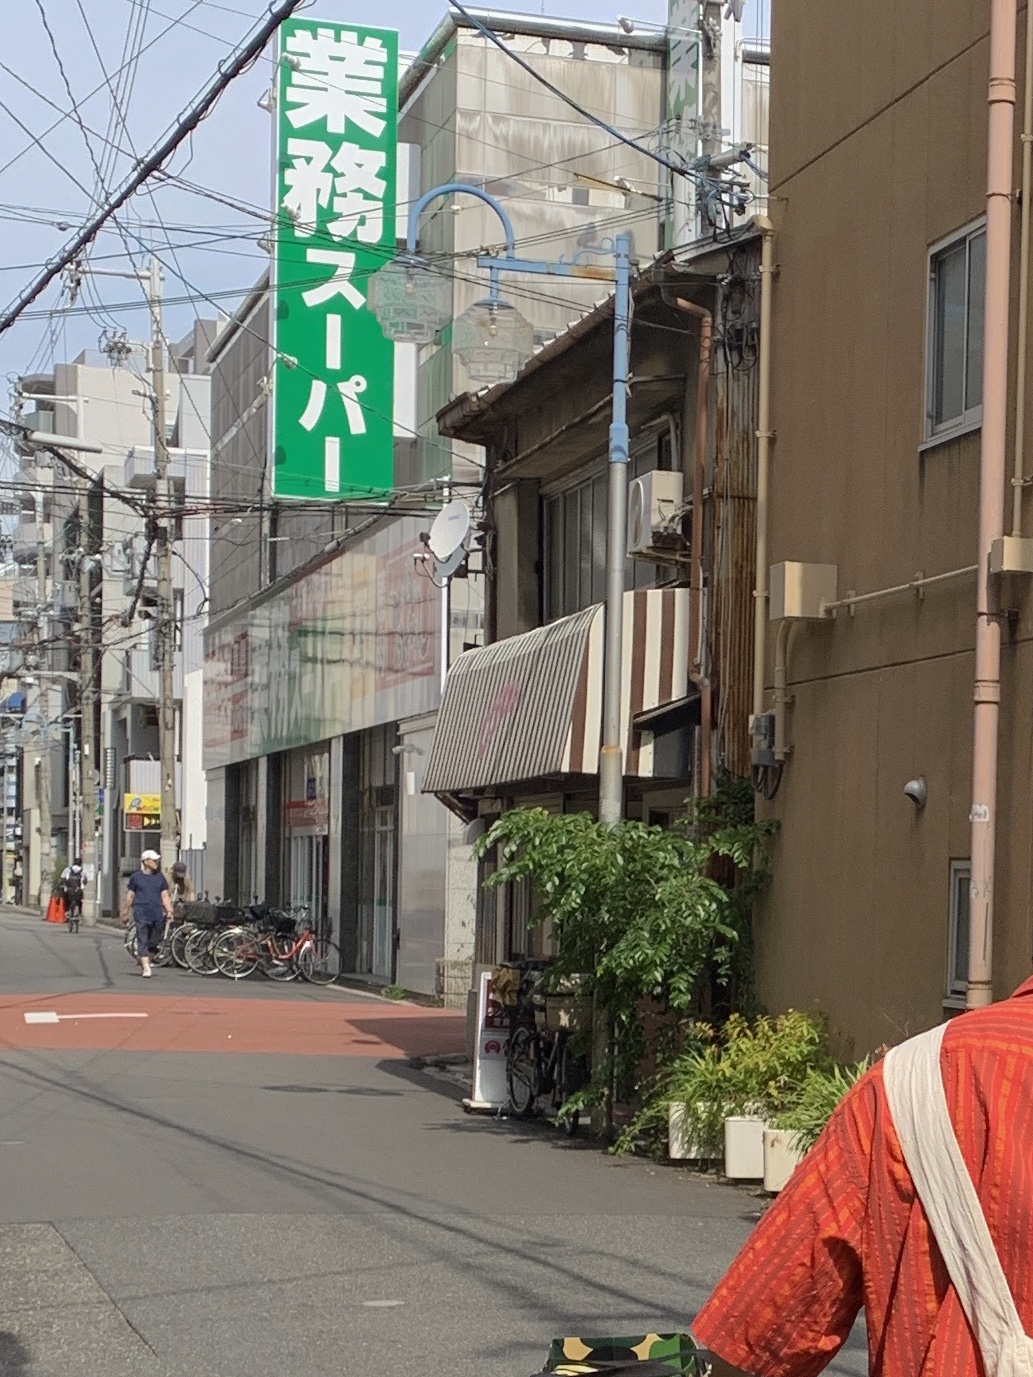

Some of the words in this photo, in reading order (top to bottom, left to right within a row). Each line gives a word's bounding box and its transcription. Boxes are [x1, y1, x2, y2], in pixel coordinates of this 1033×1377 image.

[282, 29, 388, 492] 業務スーパー
